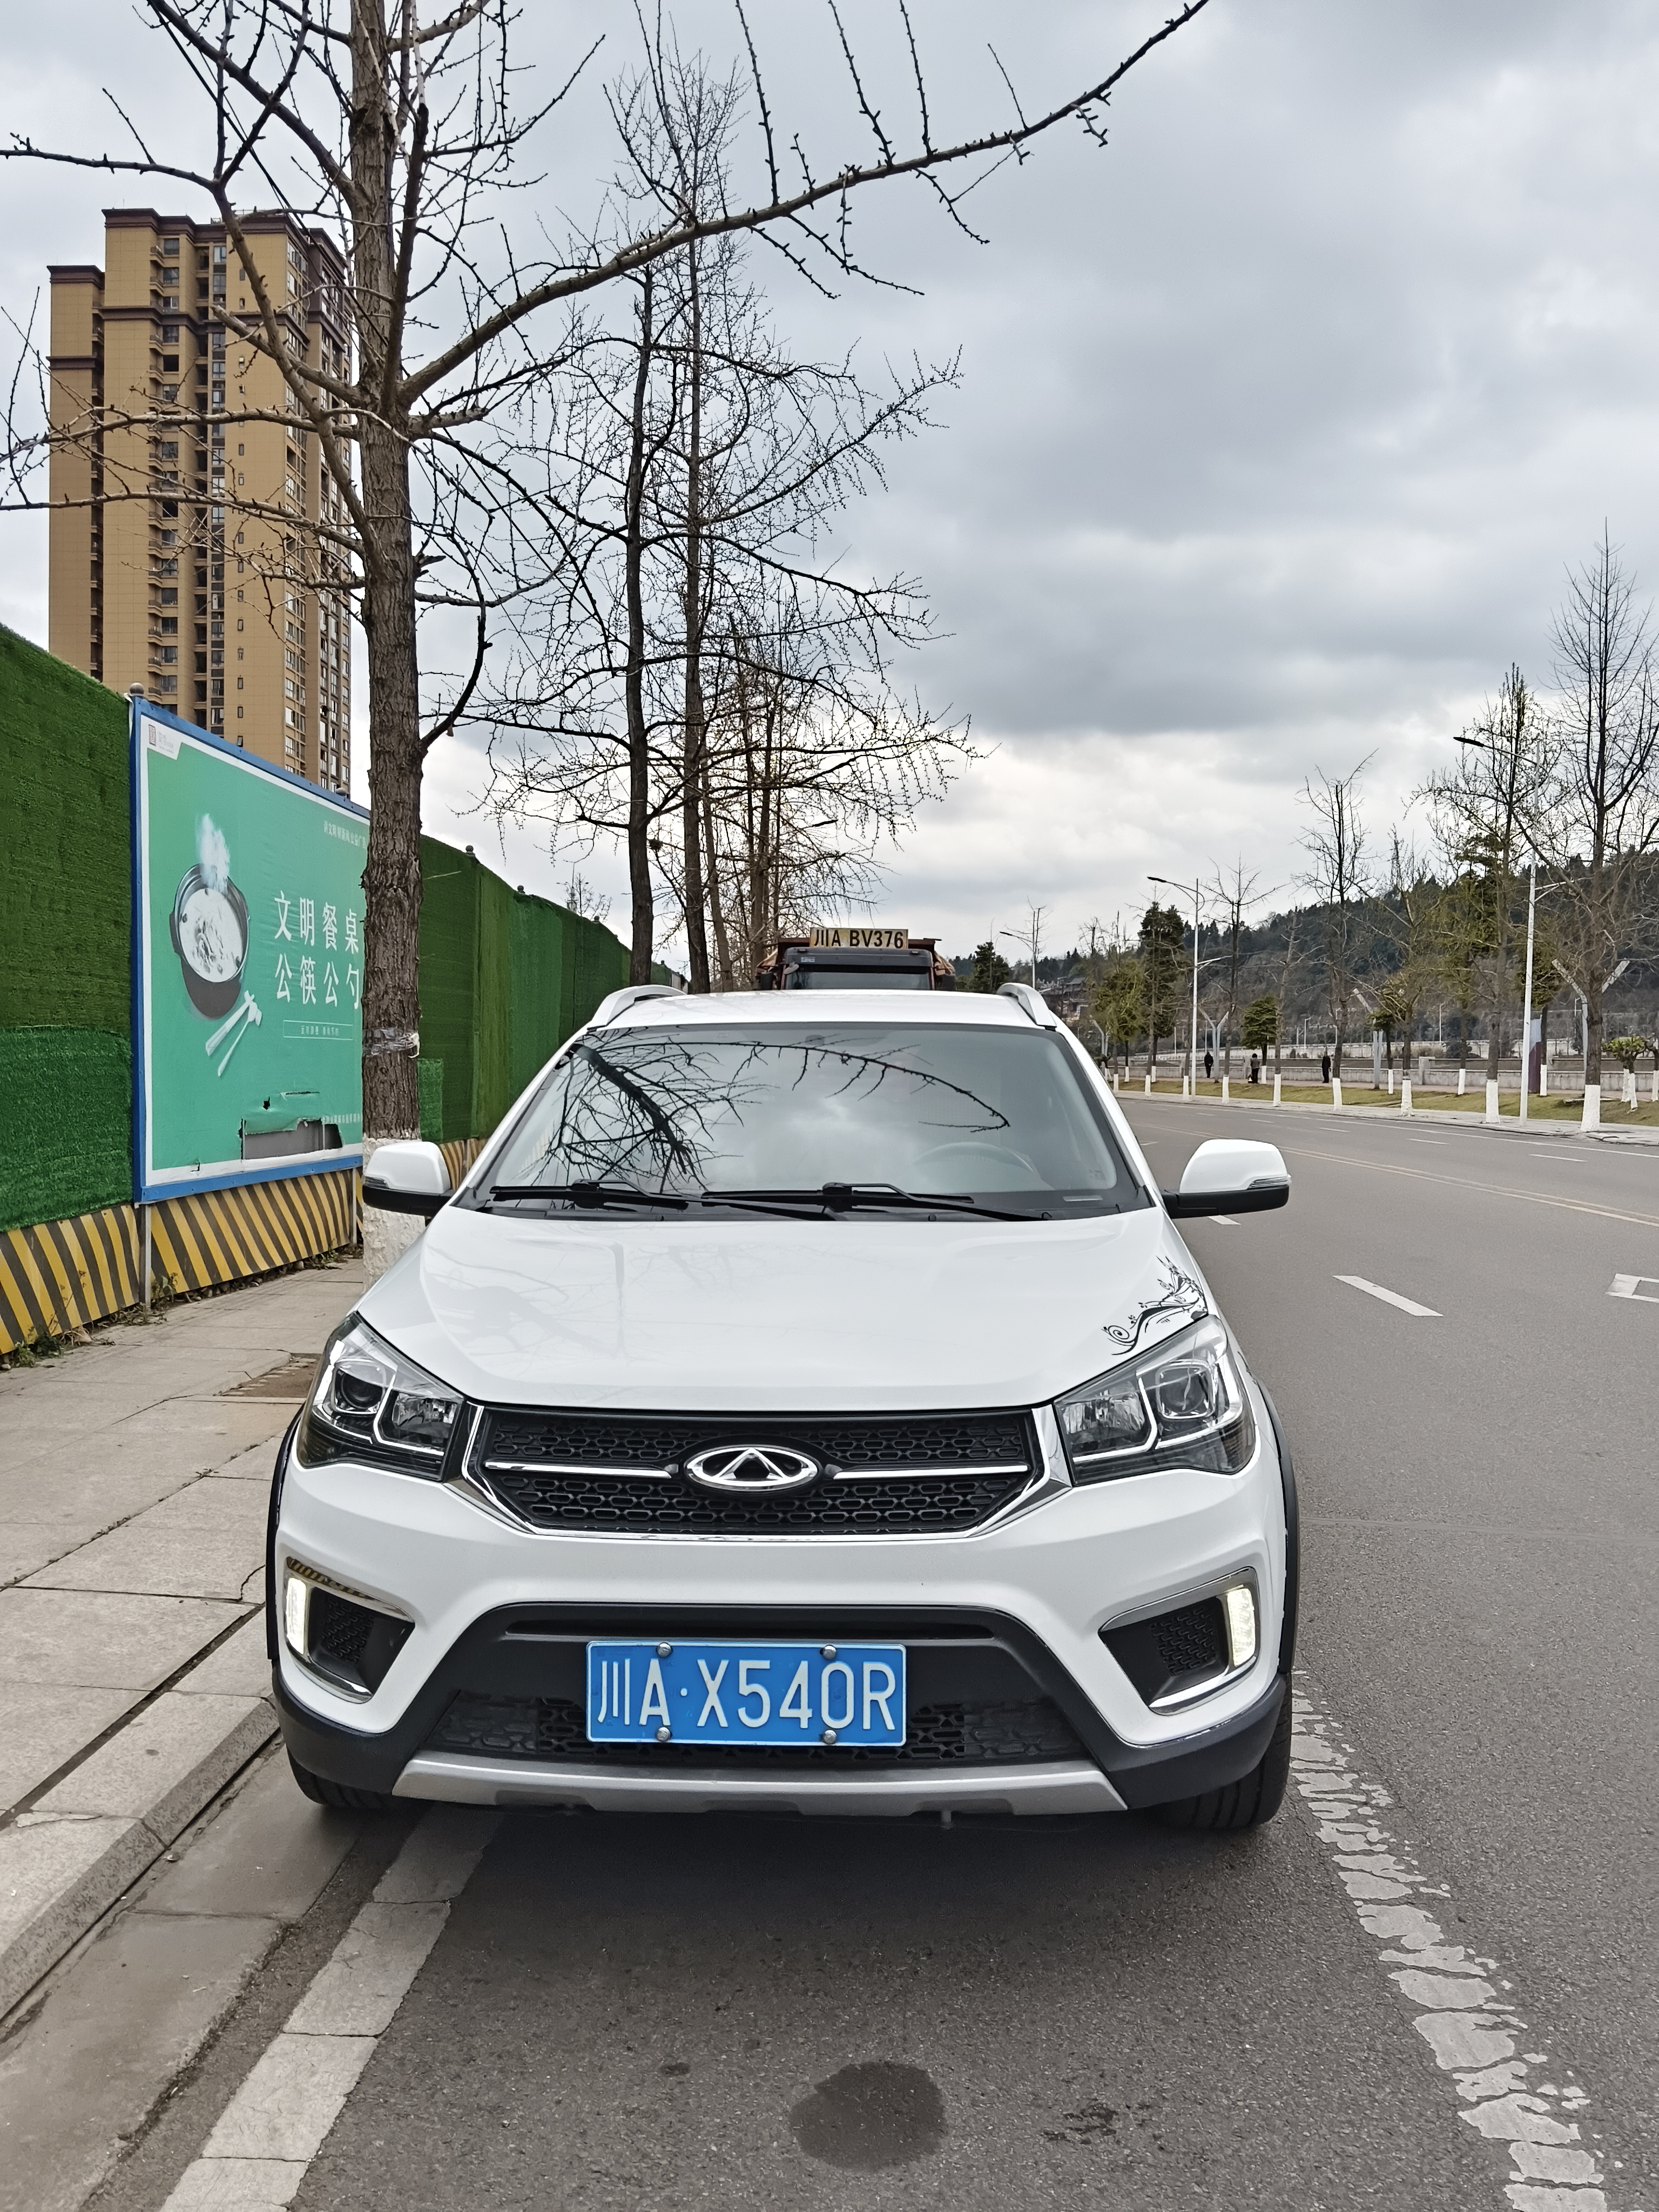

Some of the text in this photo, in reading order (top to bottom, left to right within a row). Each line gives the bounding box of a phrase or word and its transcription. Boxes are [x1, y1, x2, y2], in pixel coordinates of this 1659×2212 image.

[274, 890, 359, 954] 文明餐桌
[849, 930, 903, 948] BV376
[274, 953, 359, 1009] 公筷公勺
